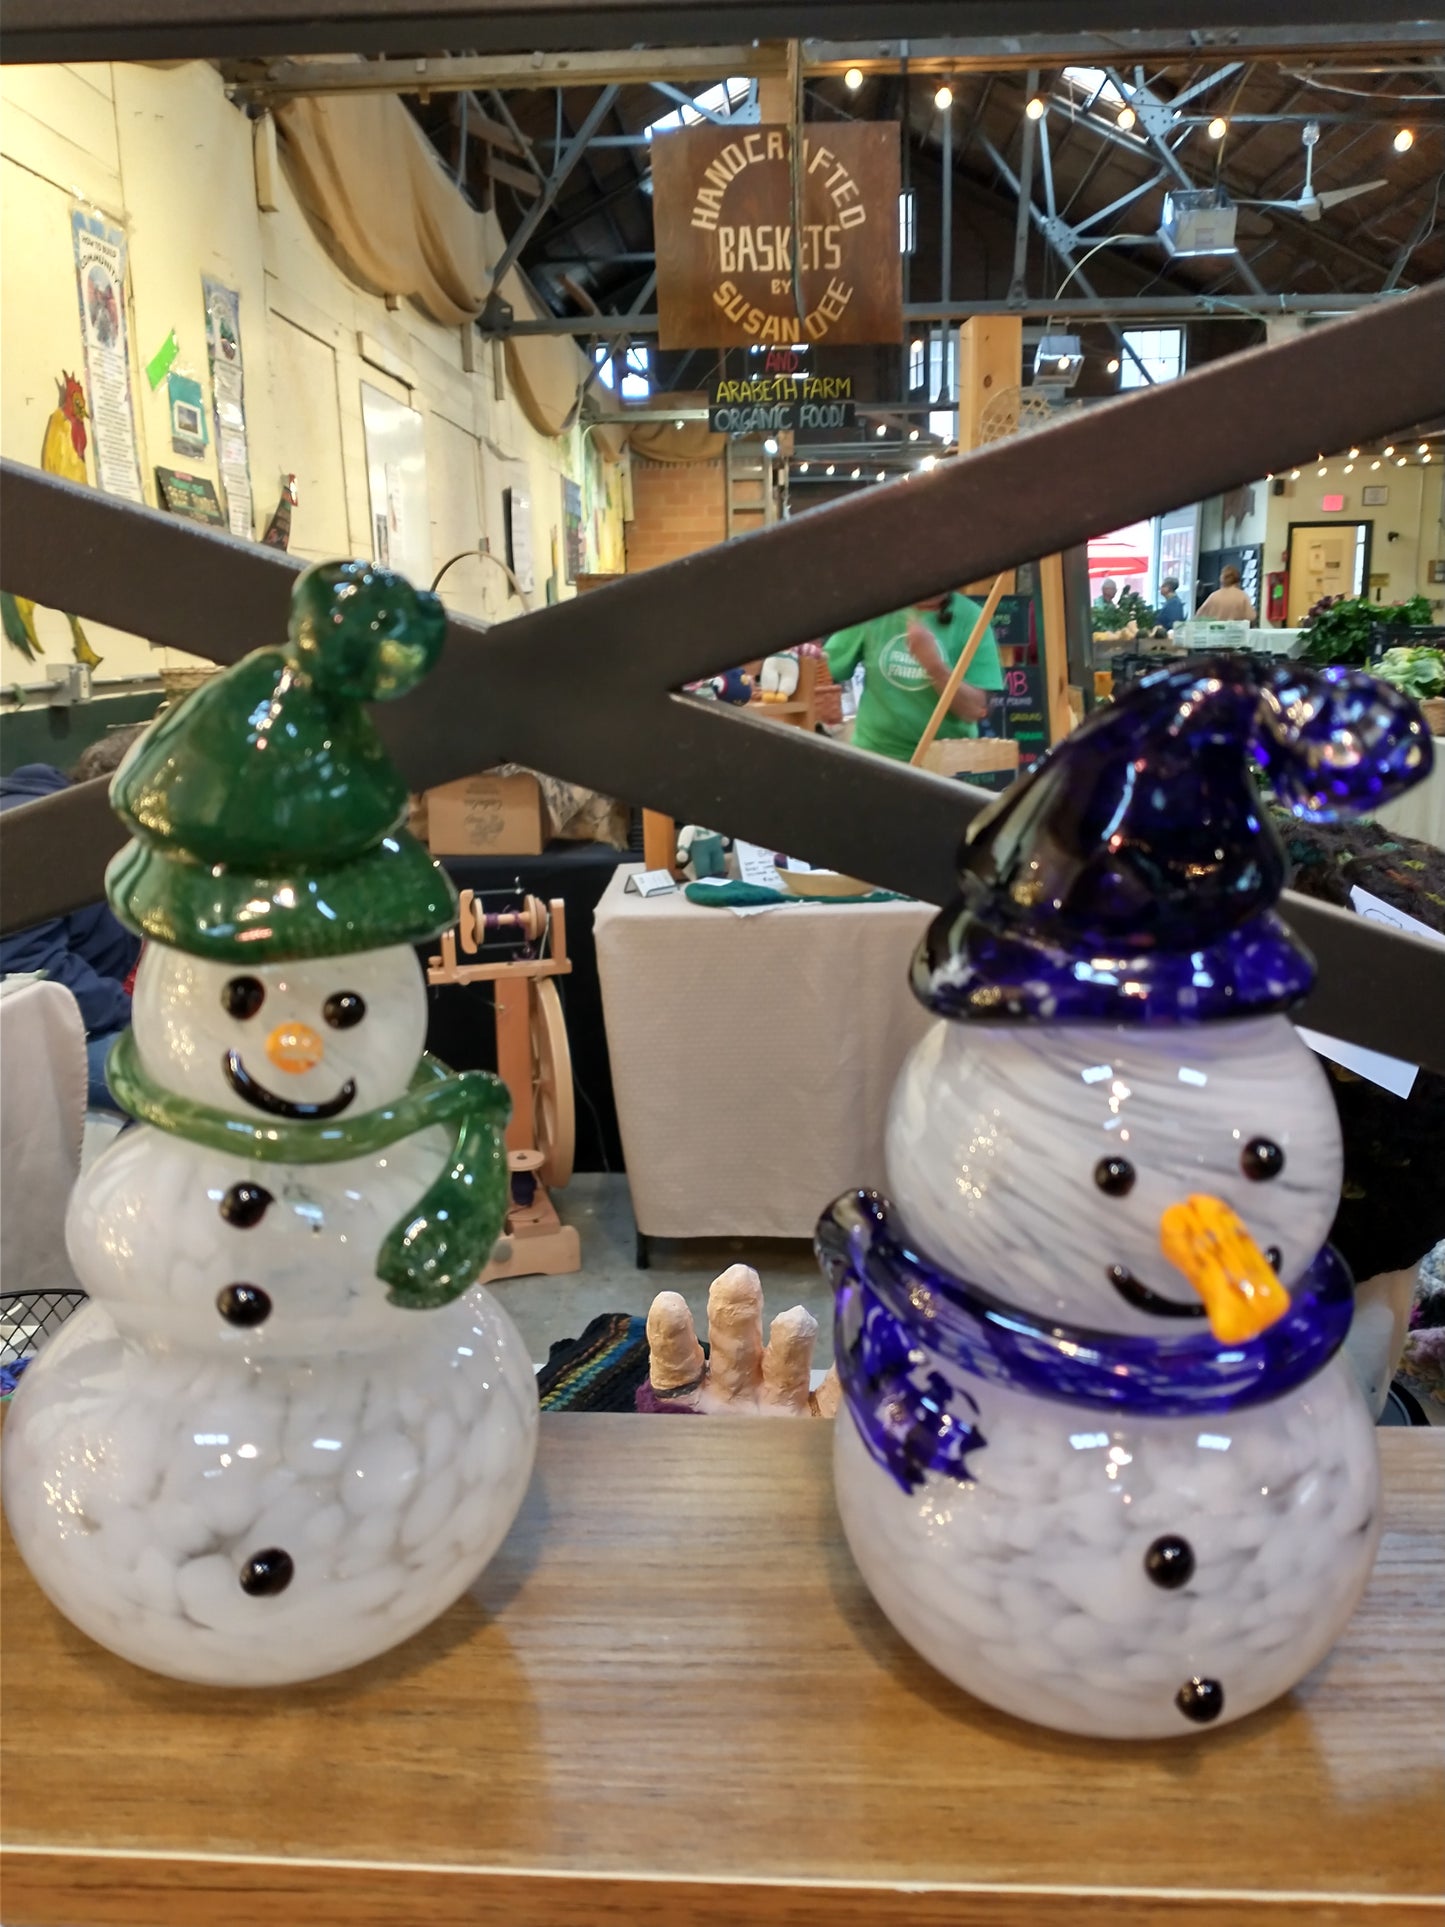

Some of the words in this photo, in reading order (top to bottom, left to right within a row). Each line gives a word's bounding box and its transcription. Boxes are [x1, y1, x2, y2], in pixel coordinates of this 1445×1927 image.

[81, 255, 121, 284] COMMUNITY
[771, 279, 792, 295] BY
[712, 280, 801, 343] SUSAN
[804, 276, 854, 340] DEE
[765, 350, 799, 372] AND
[716, 377, 798, 403] ARABETH
[803, 377, 851, 400] FARM
[714, 405, 793, 432] ORGANIC
[801, 402, 846, 428] FOOD!
